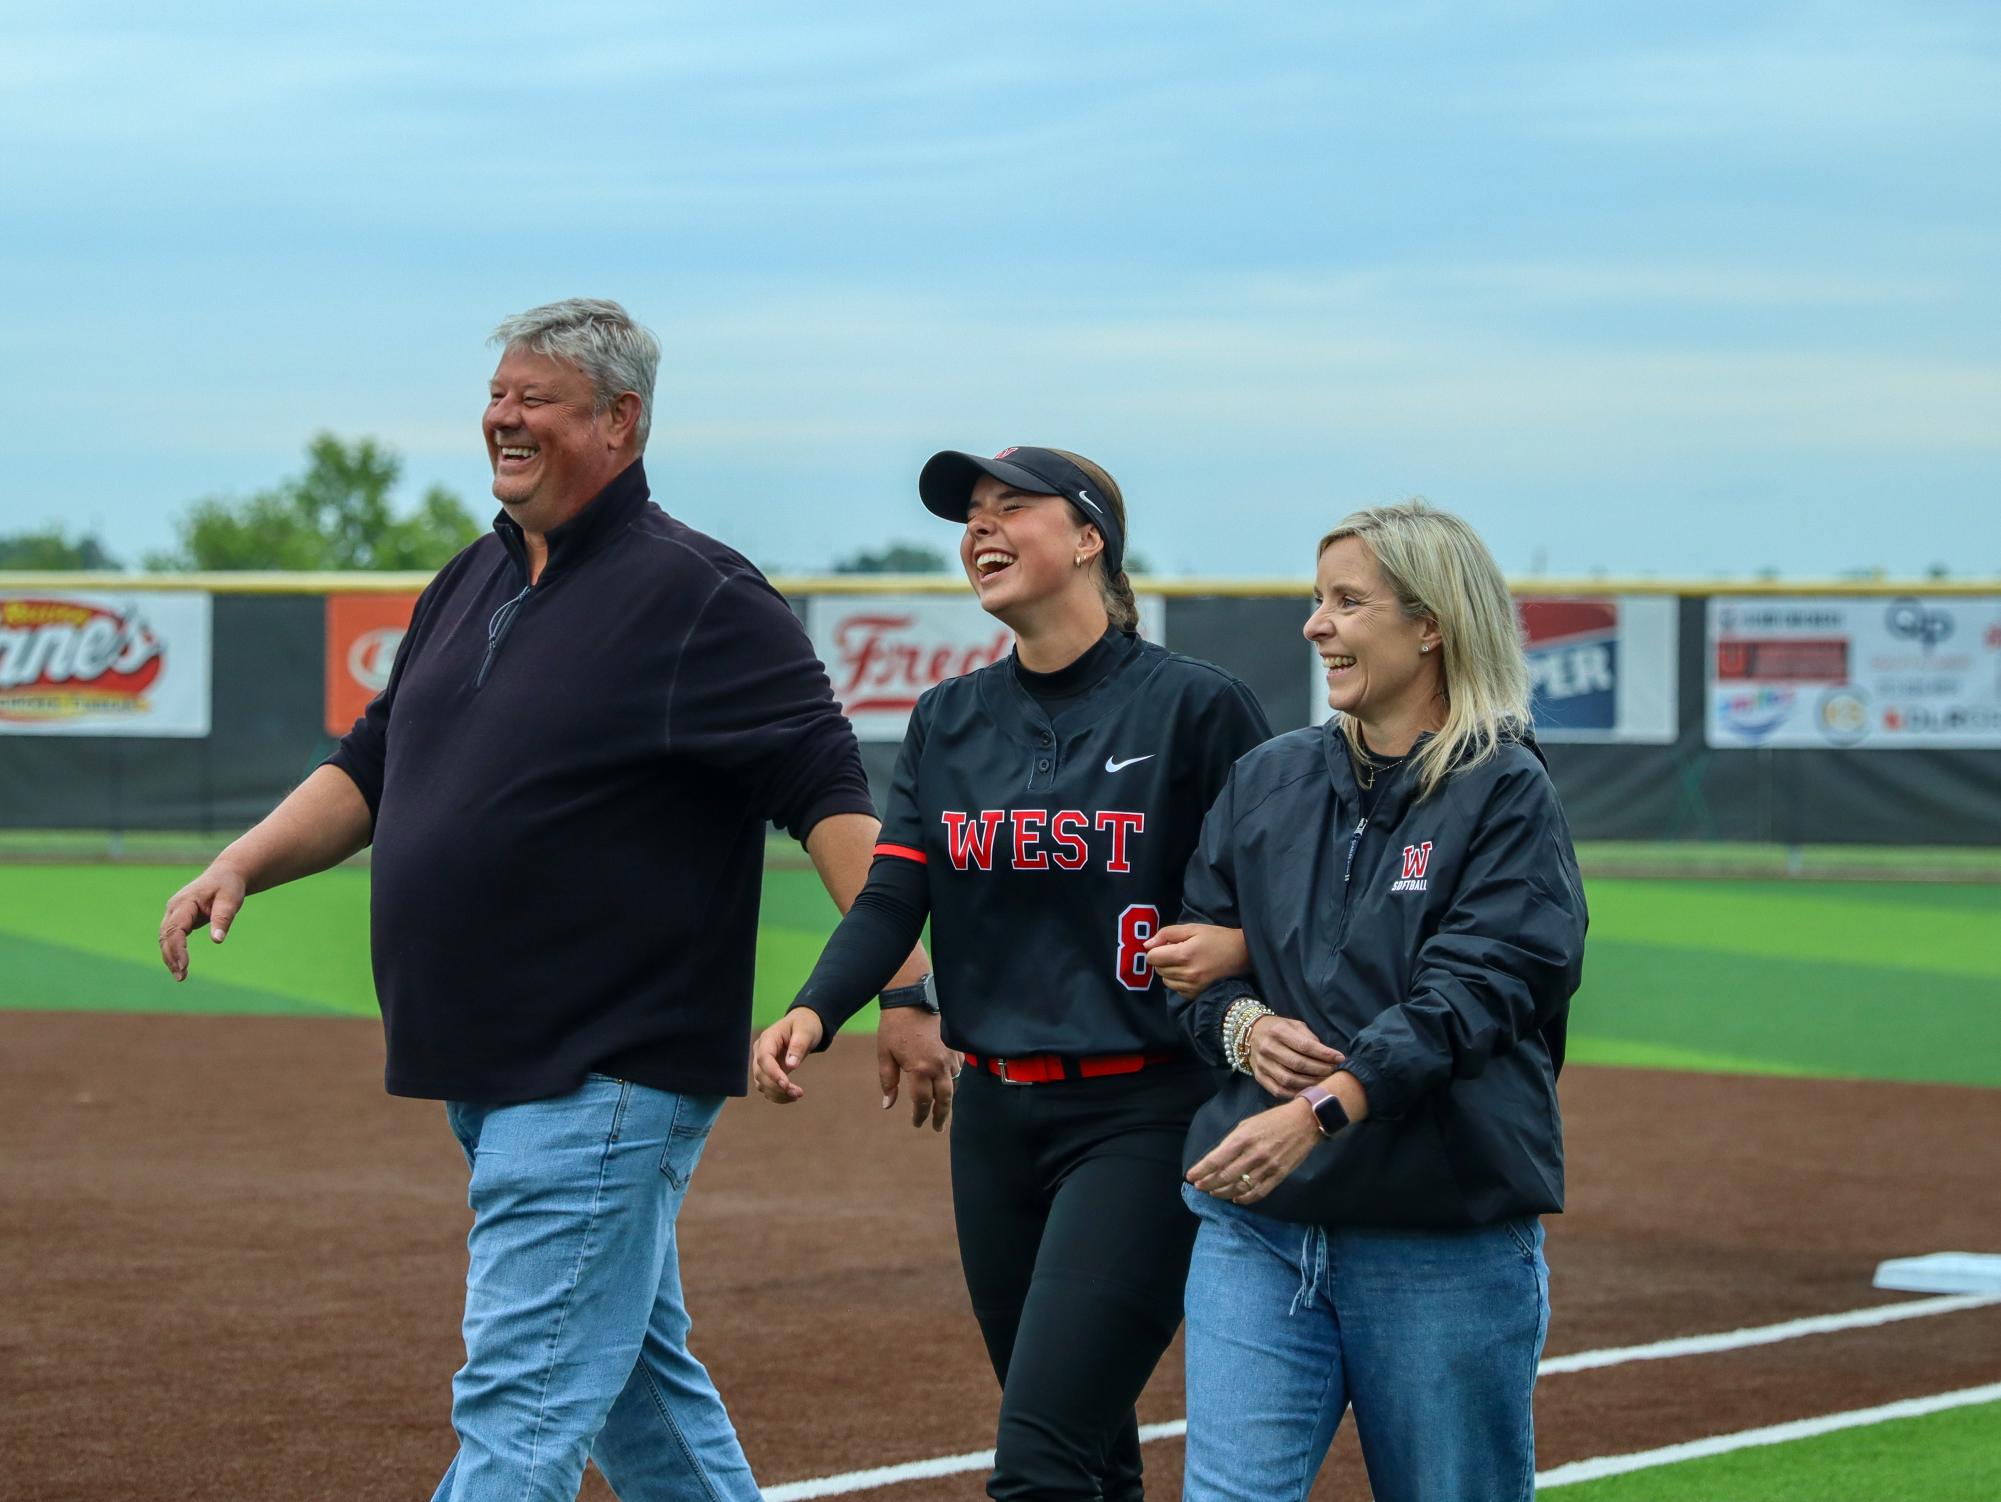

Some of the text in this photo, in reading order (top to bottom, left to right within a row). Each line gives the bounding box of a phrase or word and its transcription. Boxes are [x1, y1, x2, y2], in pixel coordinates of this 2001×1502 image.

[941, 809, 1145, 873] WEST
[1401, 840, 1433, 879] W
[1391, 879, 1428, 892] SOFTBALL
[1116, 903, 1160, 991] 8
